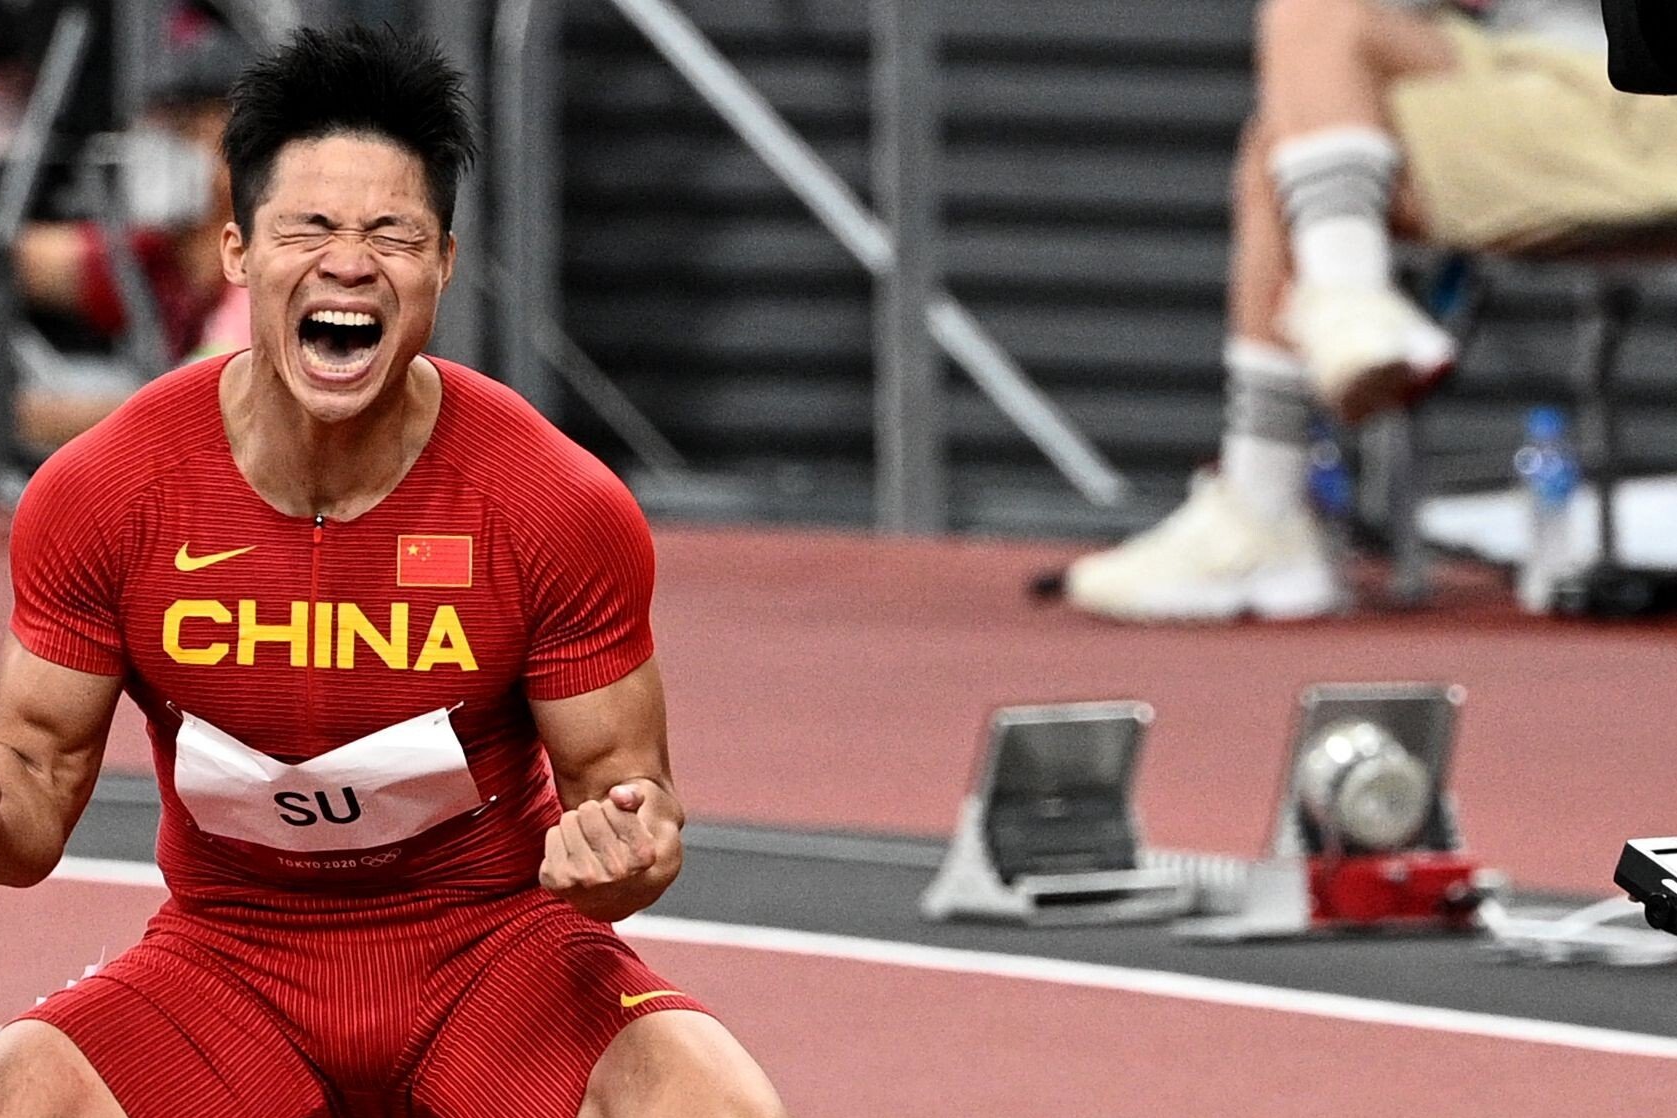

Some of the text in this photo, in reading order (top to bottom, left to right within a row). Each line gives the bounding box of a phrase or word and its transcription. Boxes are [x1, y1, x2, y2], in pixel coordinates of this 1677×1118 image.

[162, 599, 480, 671] CHINA
[274, 786, 362, 826] SU
[276, 856, 357, 869] TOKYO 2020
